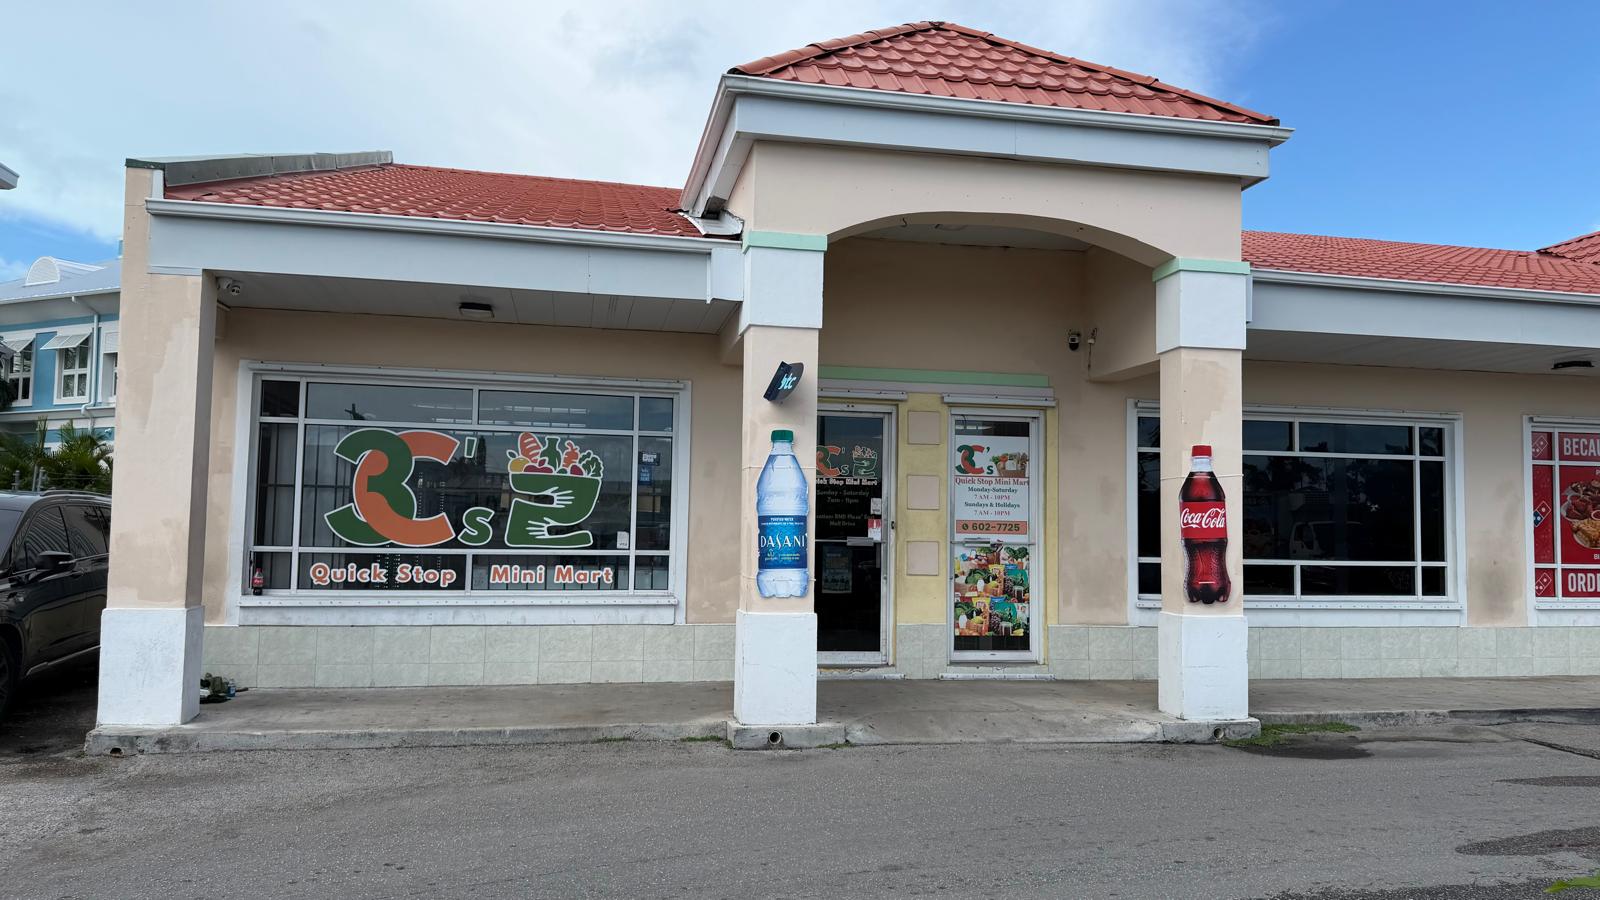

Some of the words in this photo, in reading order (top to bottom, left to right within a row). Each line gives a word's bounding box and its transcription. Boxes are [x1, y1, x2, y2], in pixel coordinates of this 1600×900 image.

[955, 477, 976, 487] Quick
[977, 478, 993, 487] Stop
[972, 522, 1020, 532] 602-7725
[1181, 508, 1225, 528] Coca-Cola
[760, 532, 805, 550] DASANI
[310, 562, 388, 586] Quick
[397, 563, 457, 587] Stop
[490, 564, 546, 584] Mini
[553, 564, 614, 584] Mart
